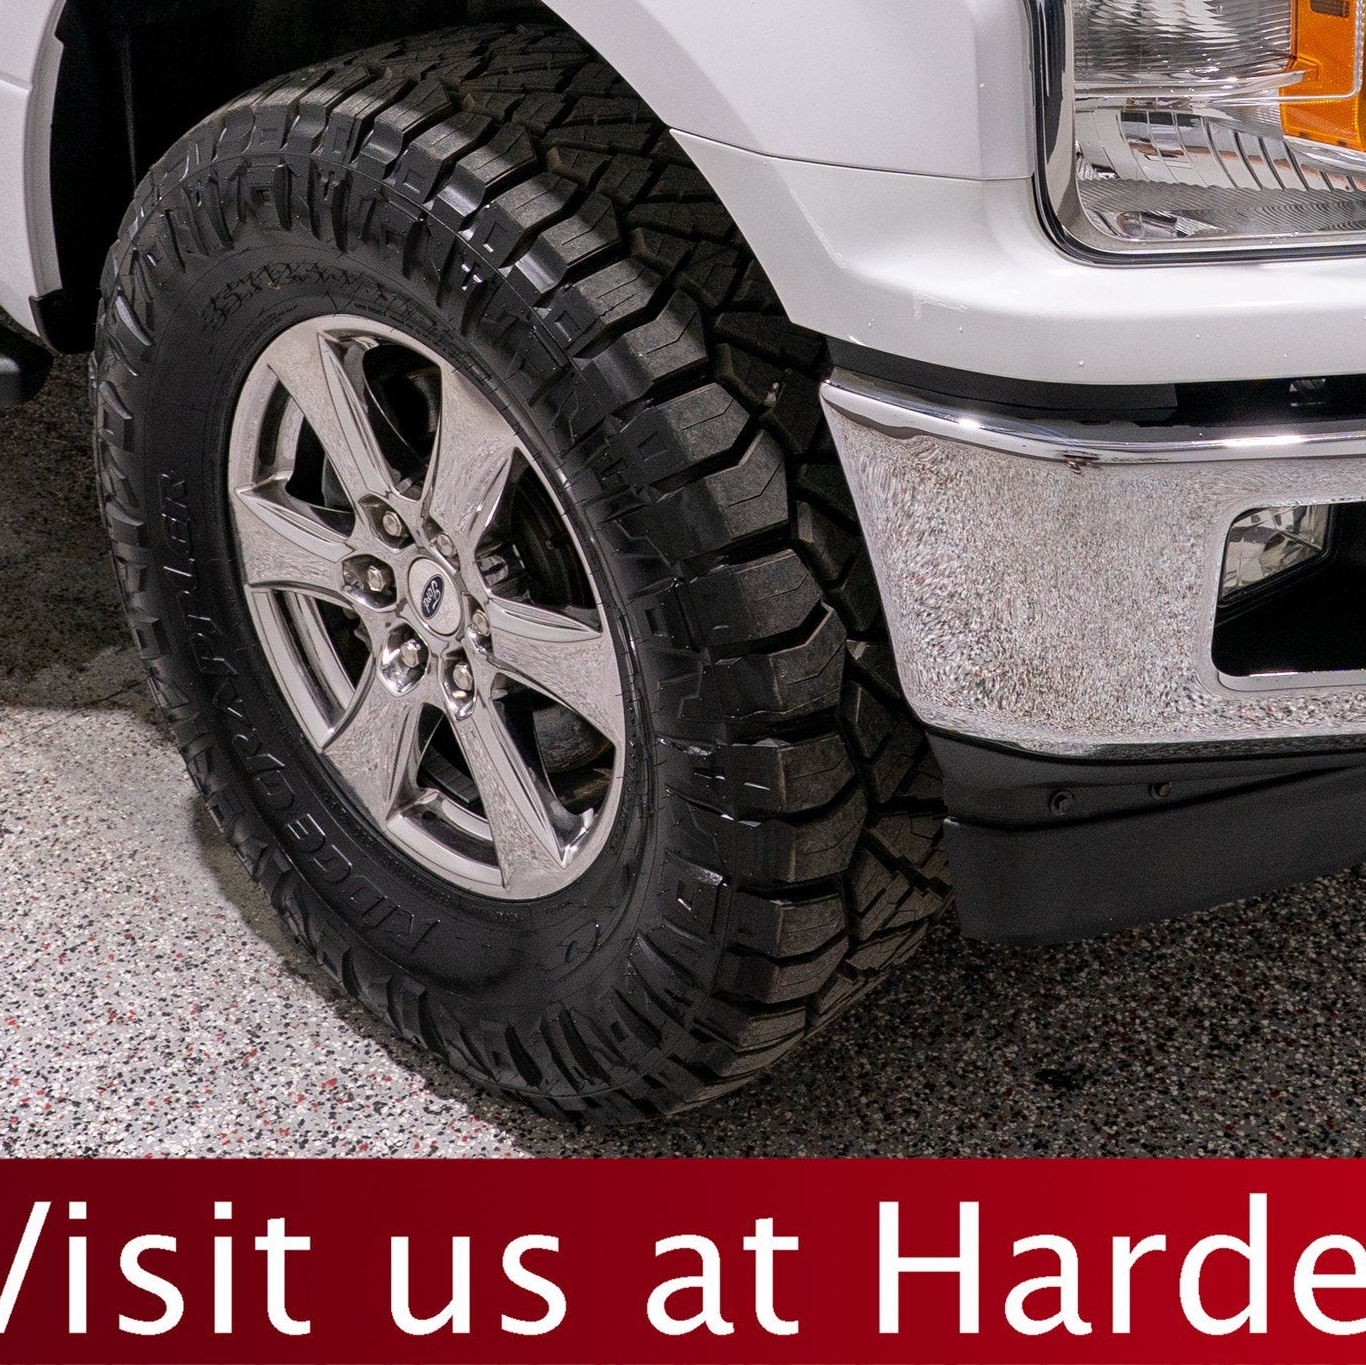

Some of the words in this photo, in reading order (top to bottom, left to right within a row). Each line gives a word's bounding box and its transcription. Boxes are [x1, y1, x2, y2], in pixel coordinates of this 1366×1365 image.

[160, 471, 296, 812] GRAPPLER
[422, 579, 442, 614] Ford
[286, 813, 441, 957] RIDGE
